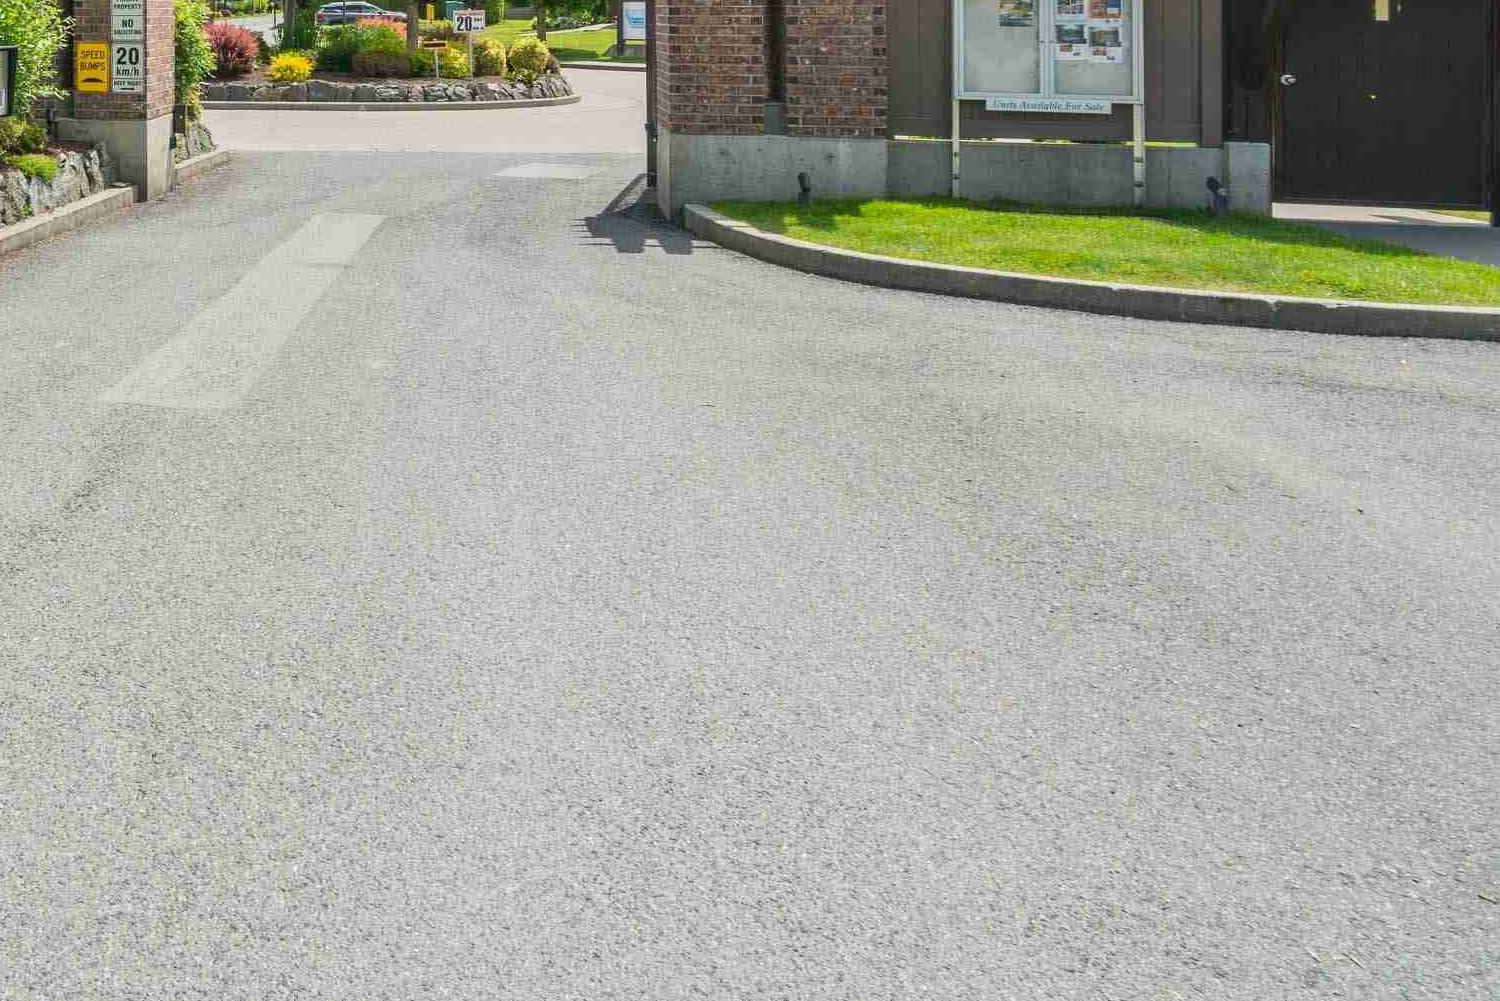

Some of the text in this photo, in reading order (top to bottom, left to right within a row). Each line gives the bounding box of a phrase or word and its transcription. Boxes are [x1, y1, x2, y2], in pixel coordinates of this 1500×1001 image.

[121, 19, 134, 27] NO
[457, 16, 472, 31] 20
[81, 49, 105, 59] SPEED
[116, 47, 139, 65] 20
[80, 62, 106, 72] BUMPS
[116, 66, 140, 76] km/h
[1020, 101, 1061, 111] Available
[1066, 102, 1081, 111] For
[1084, 102, 1105, 112] Sale
